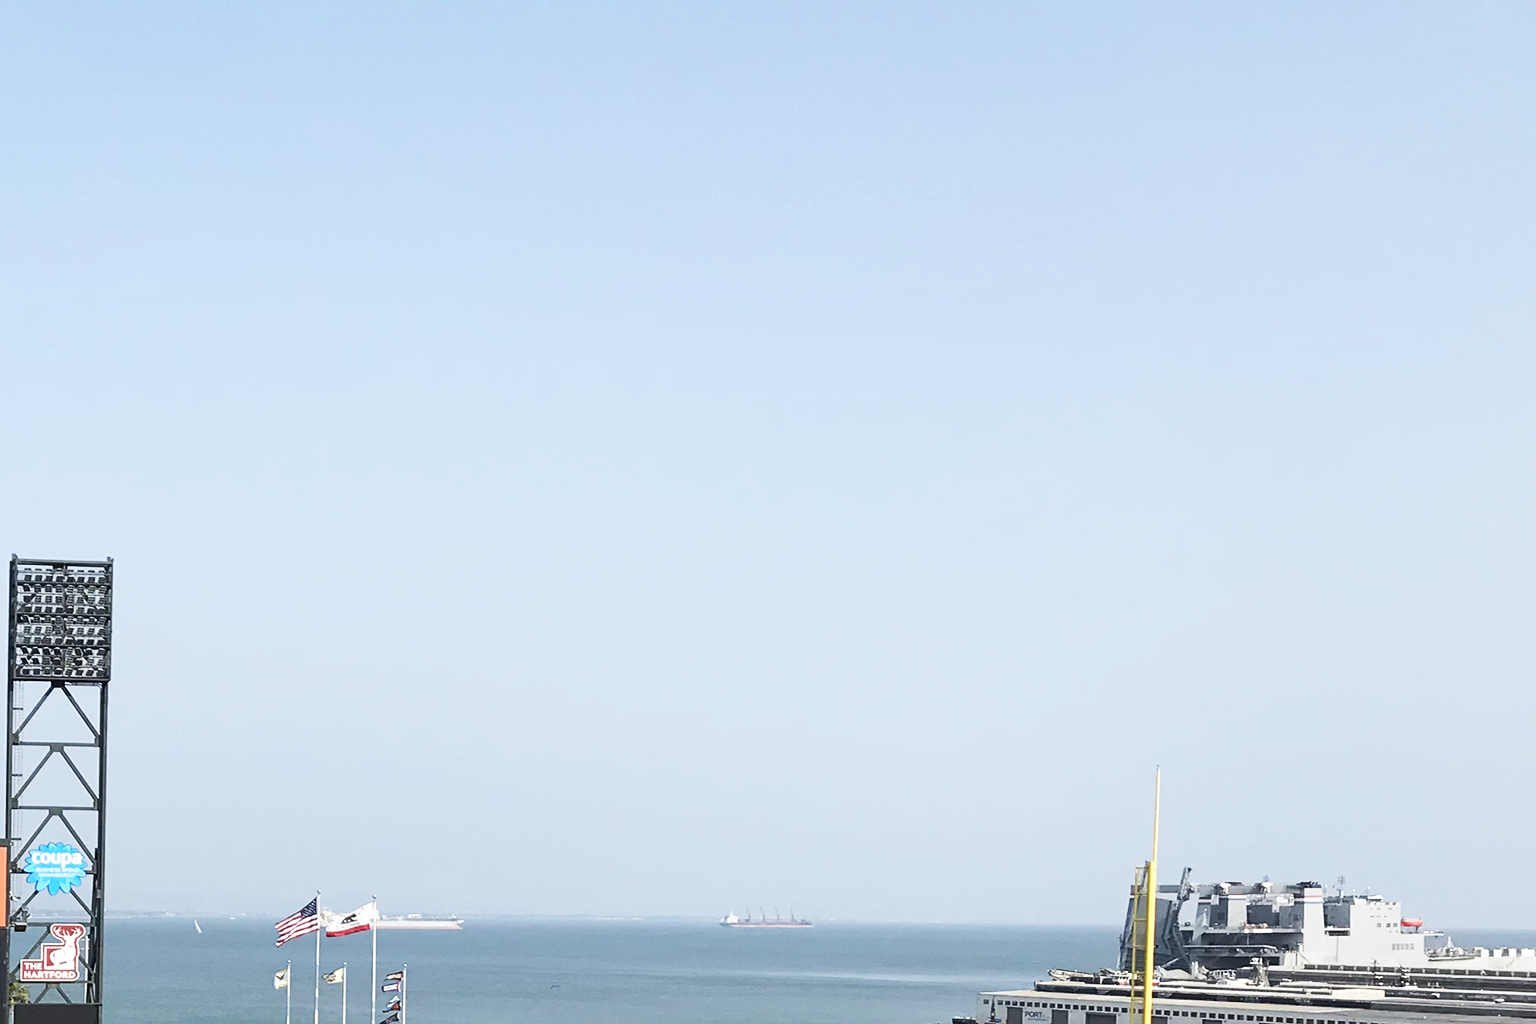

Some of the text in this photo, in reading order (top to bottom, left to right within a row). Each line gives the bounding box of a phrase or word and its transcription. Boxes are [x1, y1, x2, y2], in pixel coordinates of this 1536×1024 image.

[32, 852, 83, 868] coupa
[24, 962, 42, 970] THE
[24, 970, 77, 979] HARTFORD
[1024, 1010, 1043, 1018] PORT
